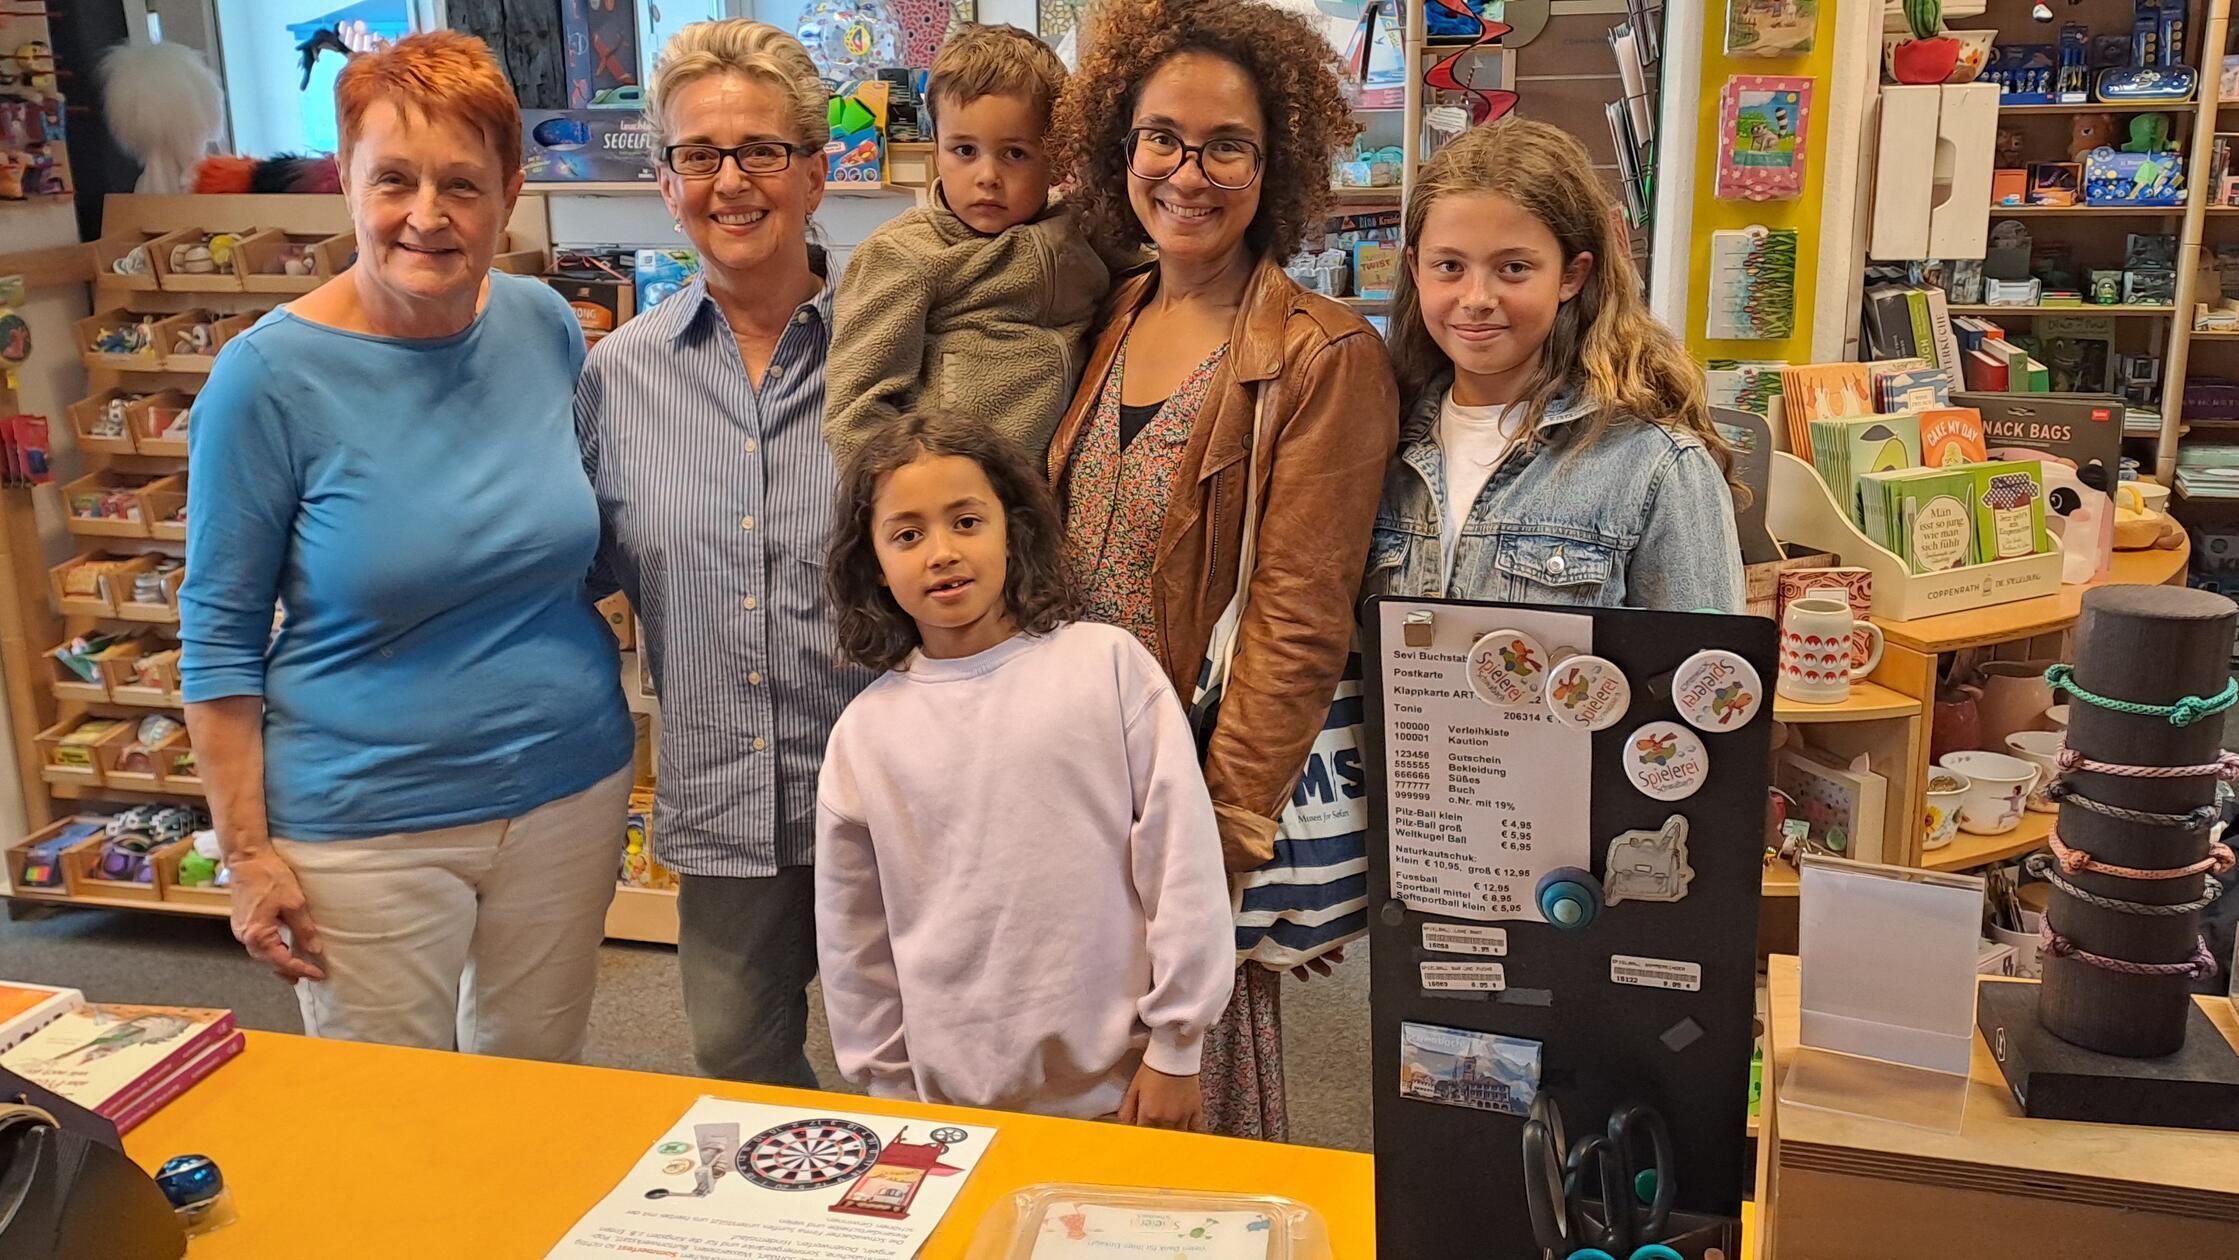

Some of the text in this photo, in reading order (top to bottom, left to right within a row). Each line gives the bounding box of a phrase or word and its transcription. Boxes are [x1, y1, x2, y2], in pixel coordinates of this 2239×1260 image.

[1926, 420, 1979, 447] CAKE MY DAY
[1983, 420, 2072, 441] NACK BAGS
[1931, 508, 1951, 518] Man
[1923, 529, 1959, 540] wie man
[1921, 541, 1938, 551] sich
[1927, 584, 1980, 600] COPPENRATH
[1393, 650, 1416, 660] Sevi
[1393, 668, 1443, 679] Postkarte
[1475, 651, 1526, 702] Spielerei
[1393, 686, 1450, 698] Klappkarte
[1681, 659, 1736, 712] Spielerei
[1393, 703, 1423, 714] Tonie
[1575, 675, 1619, 727] Spielerei
[1504, 712, 1541, 721] 206314
[1395, 722, 1509, 737] 100000 Verleihkiste
[1448, 736, 1489, 746] Kaution
[1395, 750, 1501, 764] 123456 Gutschein
[1395, 760, 1506, 777] 555555 Bekleidung
[1395, 771, 1430, 780] 666666
[1638, 757, 1700, 789] Spielerei
[1395, 781, 1475, 795] 777777 Buch
[1395, 791, 1430, 801] 999999
[1475, 798, 1492, 807] mit
[1495, 801, 1515, 811] 19%
[1395, 807, 1532, 830] Pilz-Ball klein € 4,95
[1395, 817, 1532, 840] Pilz-Ball groß € 5,95
[1395, 828, 1531, 851] Weltkugel Ball € 6,95
[1395, 856, 1419, 865] klein
[1425, 859, 1431, 867] €
[1468, 865, 1491, 875] groß
[1494, 868, 1500, 876] €
[1504, 869, 1530, 878] 12,95
[1396, 871, 1438, 884] Fussball
[1396, 882, 1441, 895] Sportball
[1444, 888, 1471, 899] mittel
[1482, 893, 1488, 901] €
[1396, 892, 1459, 908] Softsportball
[1463, 901, 1486, 912] klein
[1492, 904, 1498, 912] €
